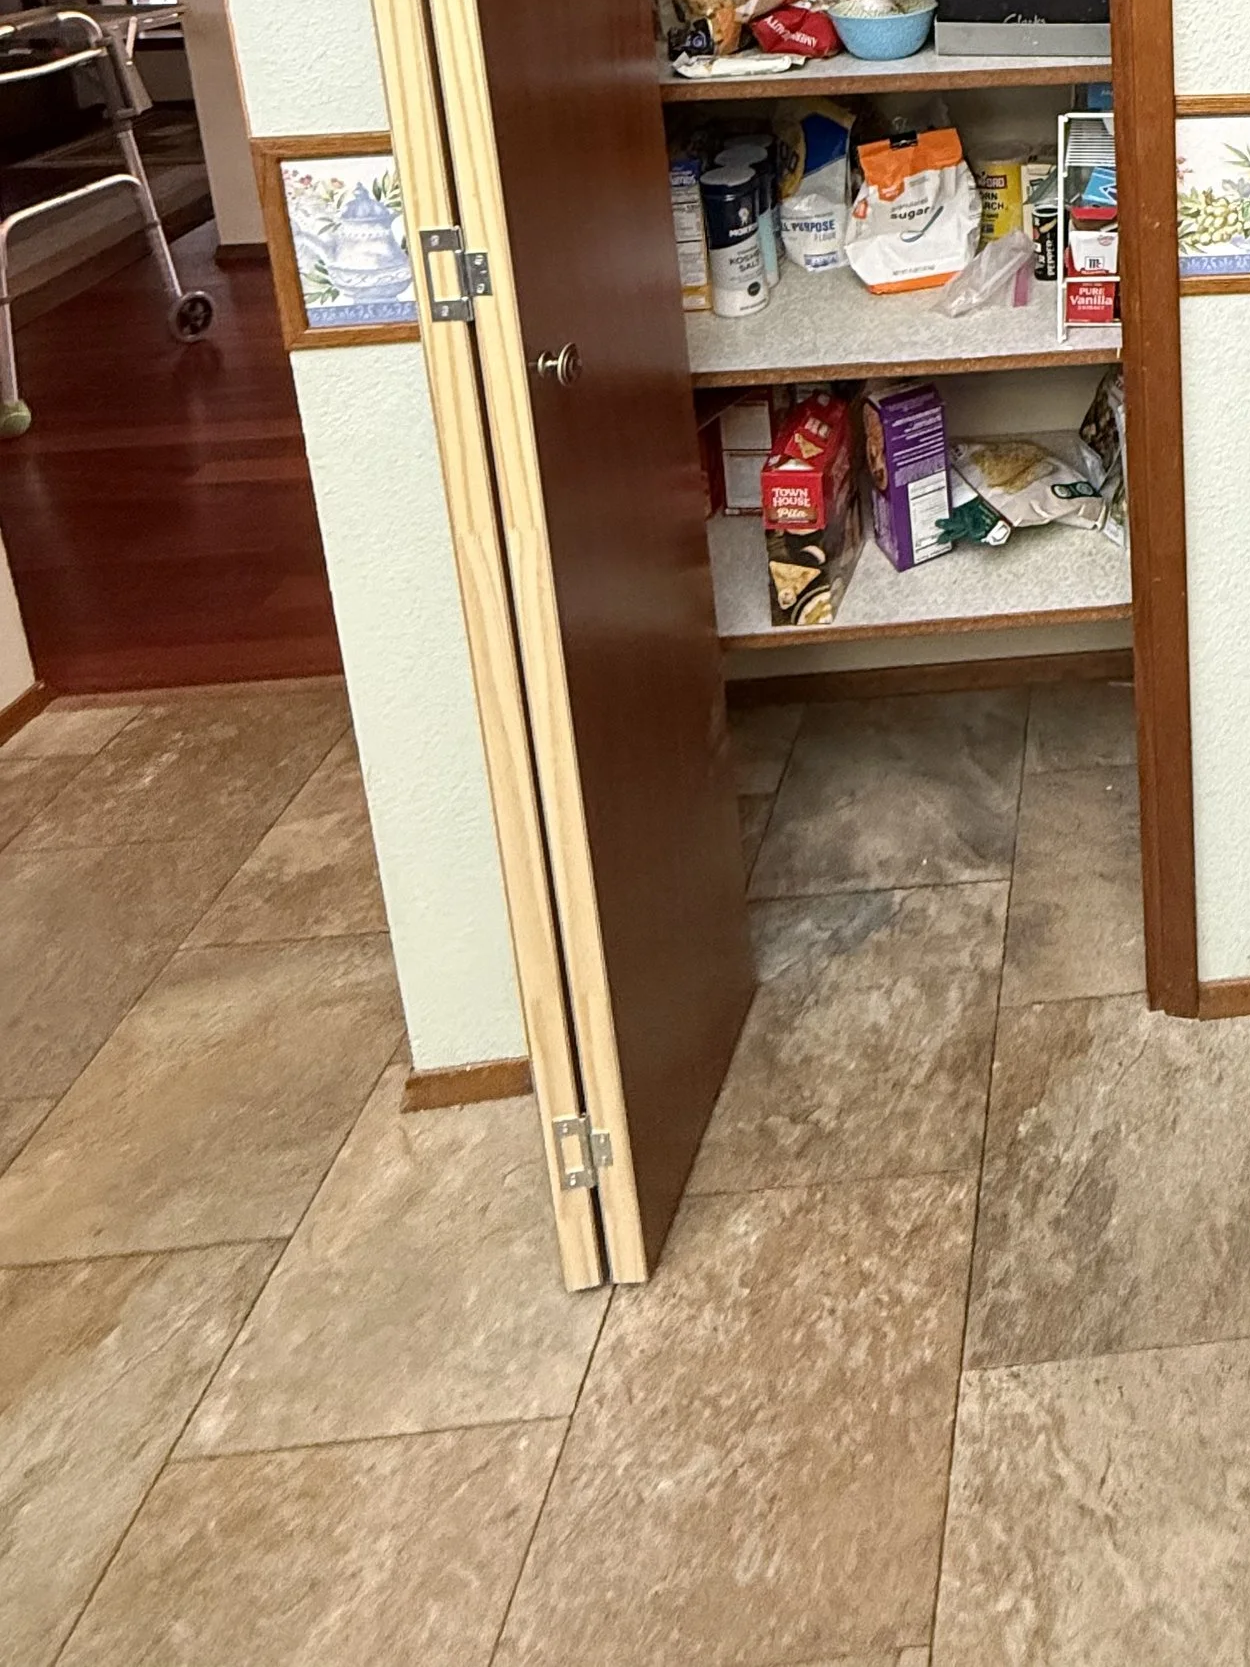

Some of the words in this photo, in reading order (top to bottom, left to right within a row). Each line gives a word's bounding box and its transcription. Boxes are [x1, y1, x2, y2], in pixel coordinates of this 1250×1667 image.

[889, 206, 932, 221] sugar
[791, 219, 835, 233] PURPOSE
[1079, 287, 1105, 296] PURE
[1070, 295, 1113, 306] Vanilla
[772, 487, 809, 498] TOWN
[772, 496, 812, 508] HOUSE
